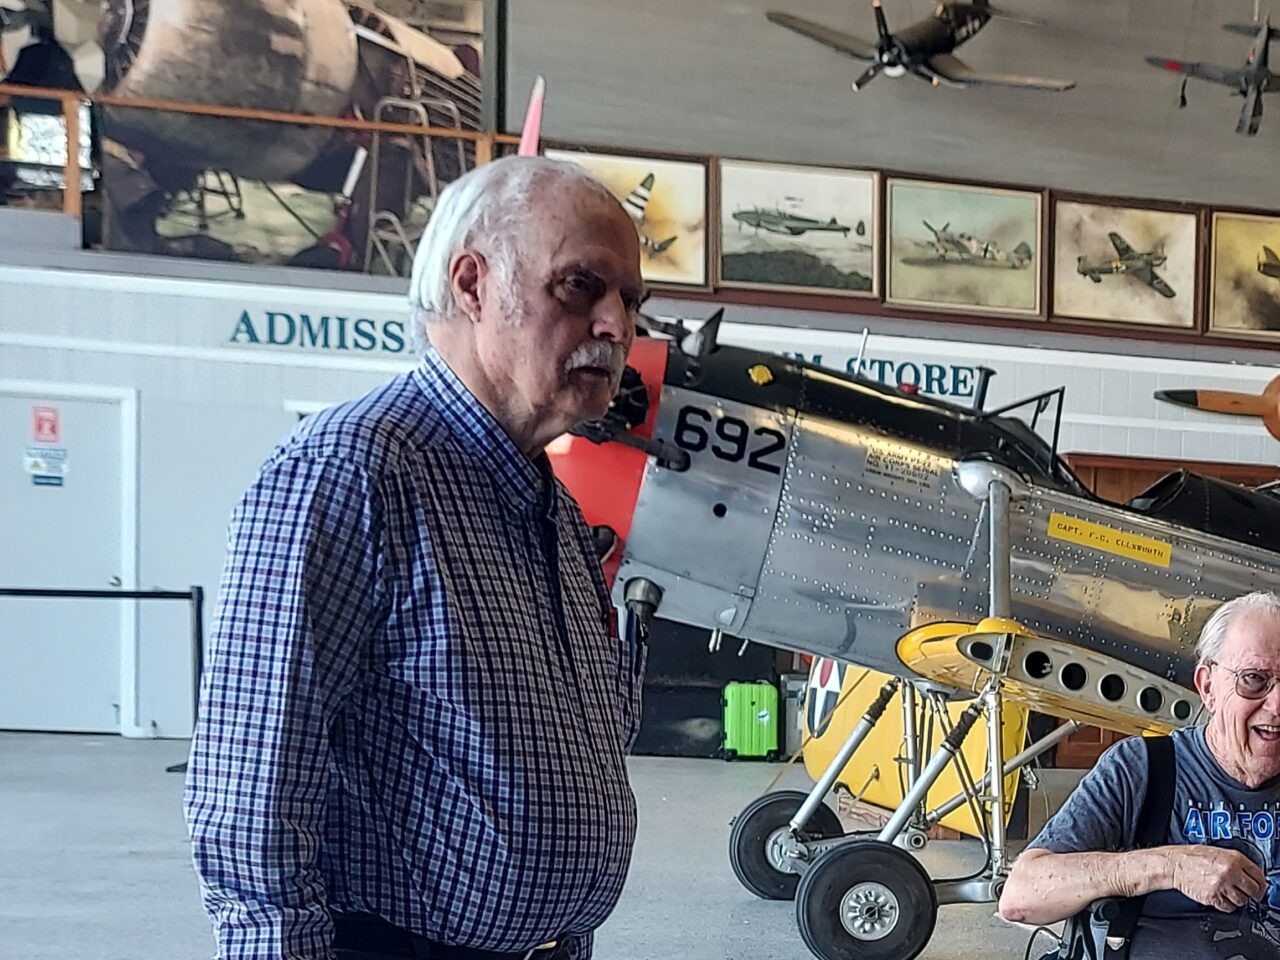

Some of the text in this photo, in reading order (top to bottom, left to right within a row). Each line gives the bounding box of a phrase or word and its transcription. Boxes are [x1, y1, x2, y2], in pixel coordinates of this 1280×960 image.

[229, 310, 415, 354] ADMISS
[674, 405, 786, 475] 692
[1057, 522, 1083, 536] CAPT.
[1116, 538, 1164, 558] ELLSWORTH
[1183, 807, 1232, 840] AIR
